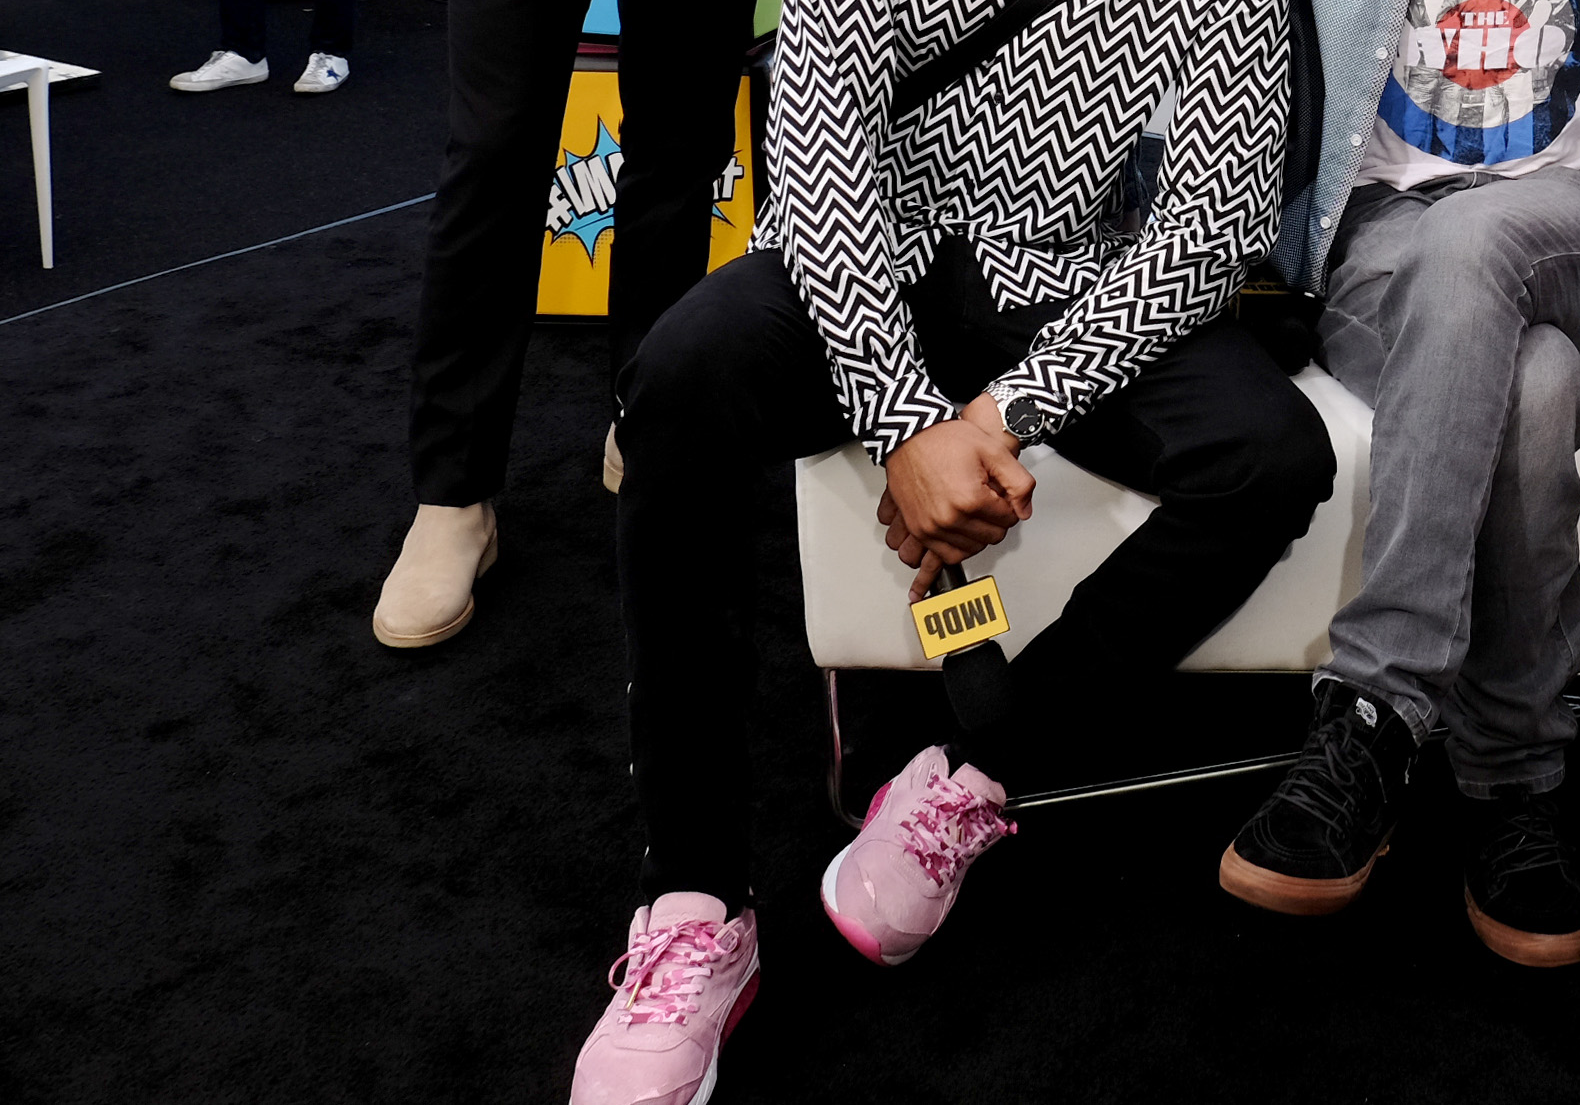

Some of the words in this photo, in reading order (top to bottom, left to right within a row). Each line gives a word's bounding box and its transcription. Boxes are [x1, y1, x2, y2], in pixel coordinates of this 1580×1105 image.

[1407, 1, 1566, 70] WHO
[1461, 11, 1510, 26] THE
[923, 593, 997, 640] IMDb
